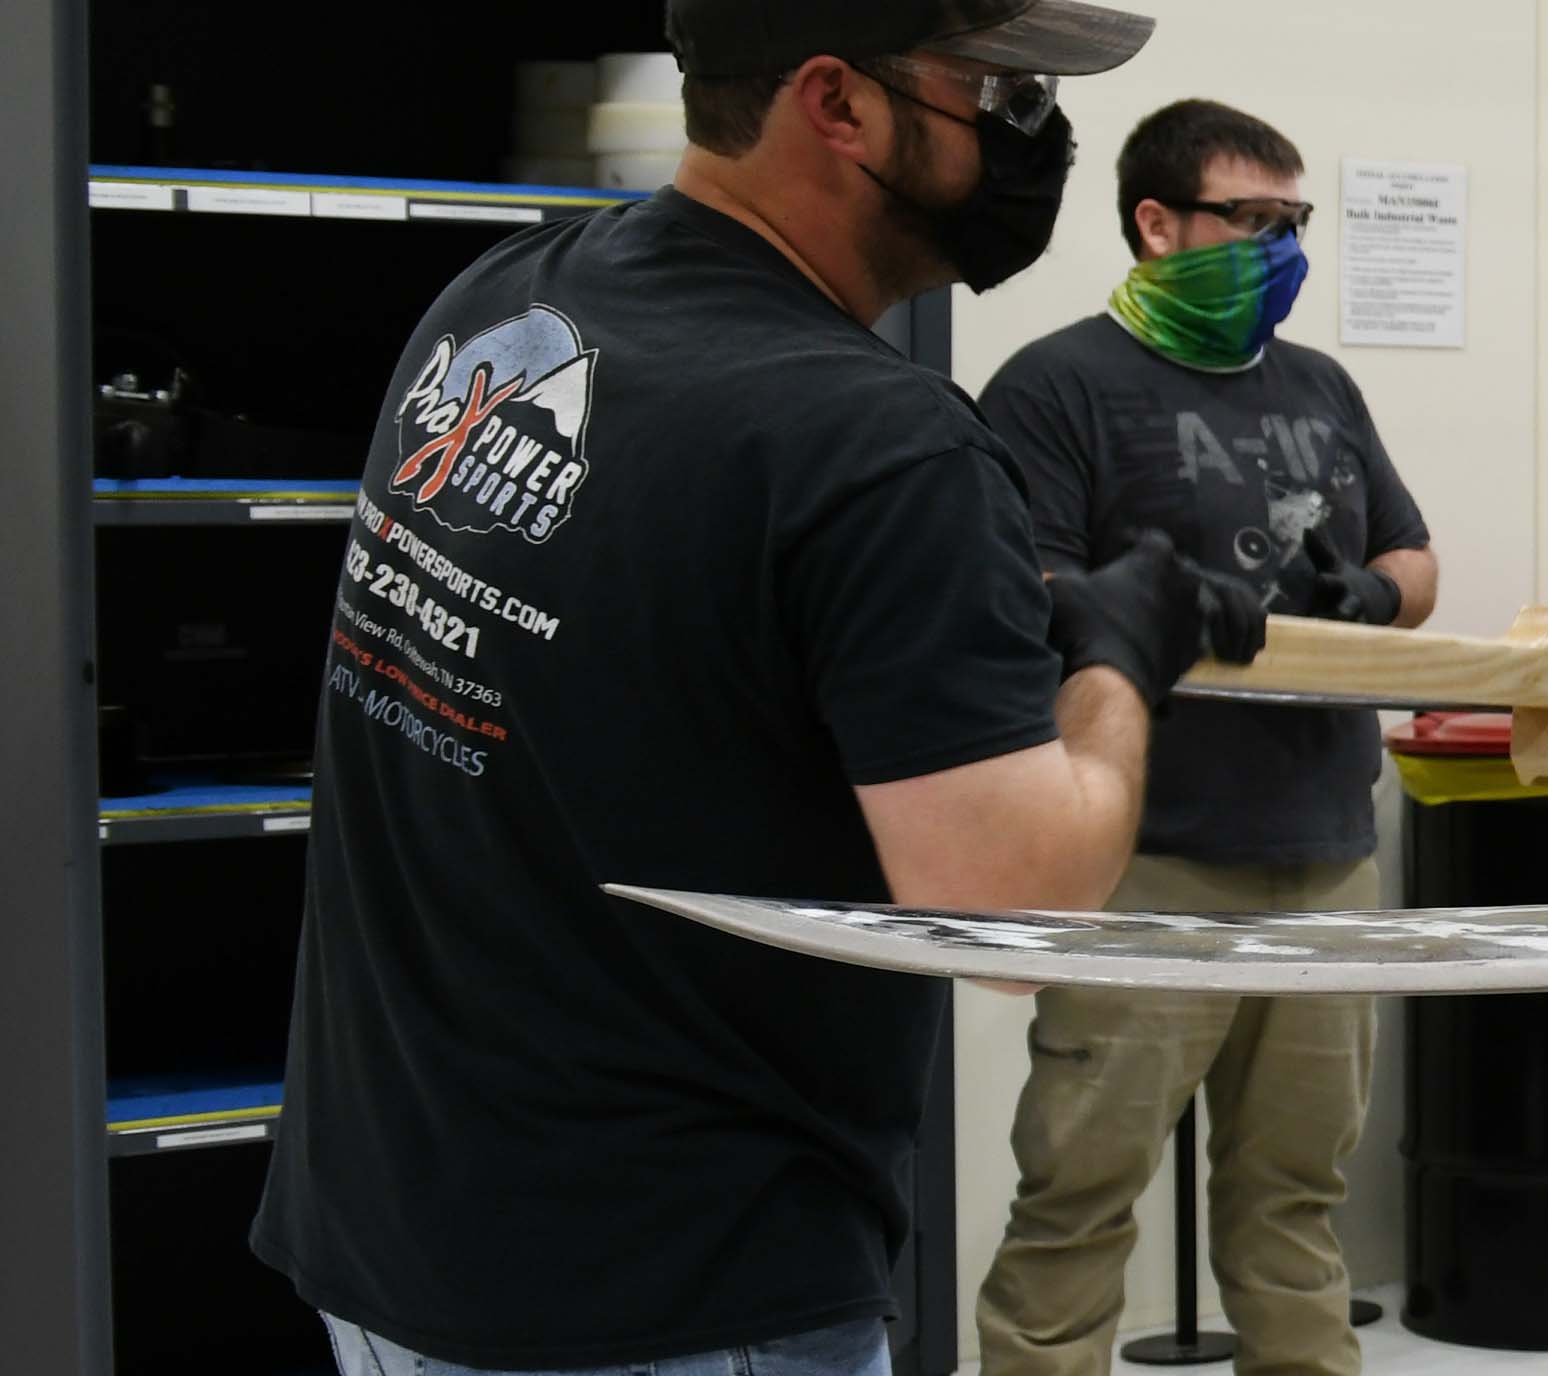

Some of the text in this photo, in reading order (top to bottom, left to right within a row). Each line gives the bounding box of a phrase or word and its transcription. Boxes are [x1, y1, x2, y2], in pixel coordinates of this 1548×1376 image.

[452, 455, 559, 537] SPORTS
[472, 415, 582, 505] POWER
[354, 611, 388, 638] View
[453, 677, 502, 708] 37363
[328, 663, 360, 699] ATV
[363, 689, 488, 777] MOTORCYCLES
